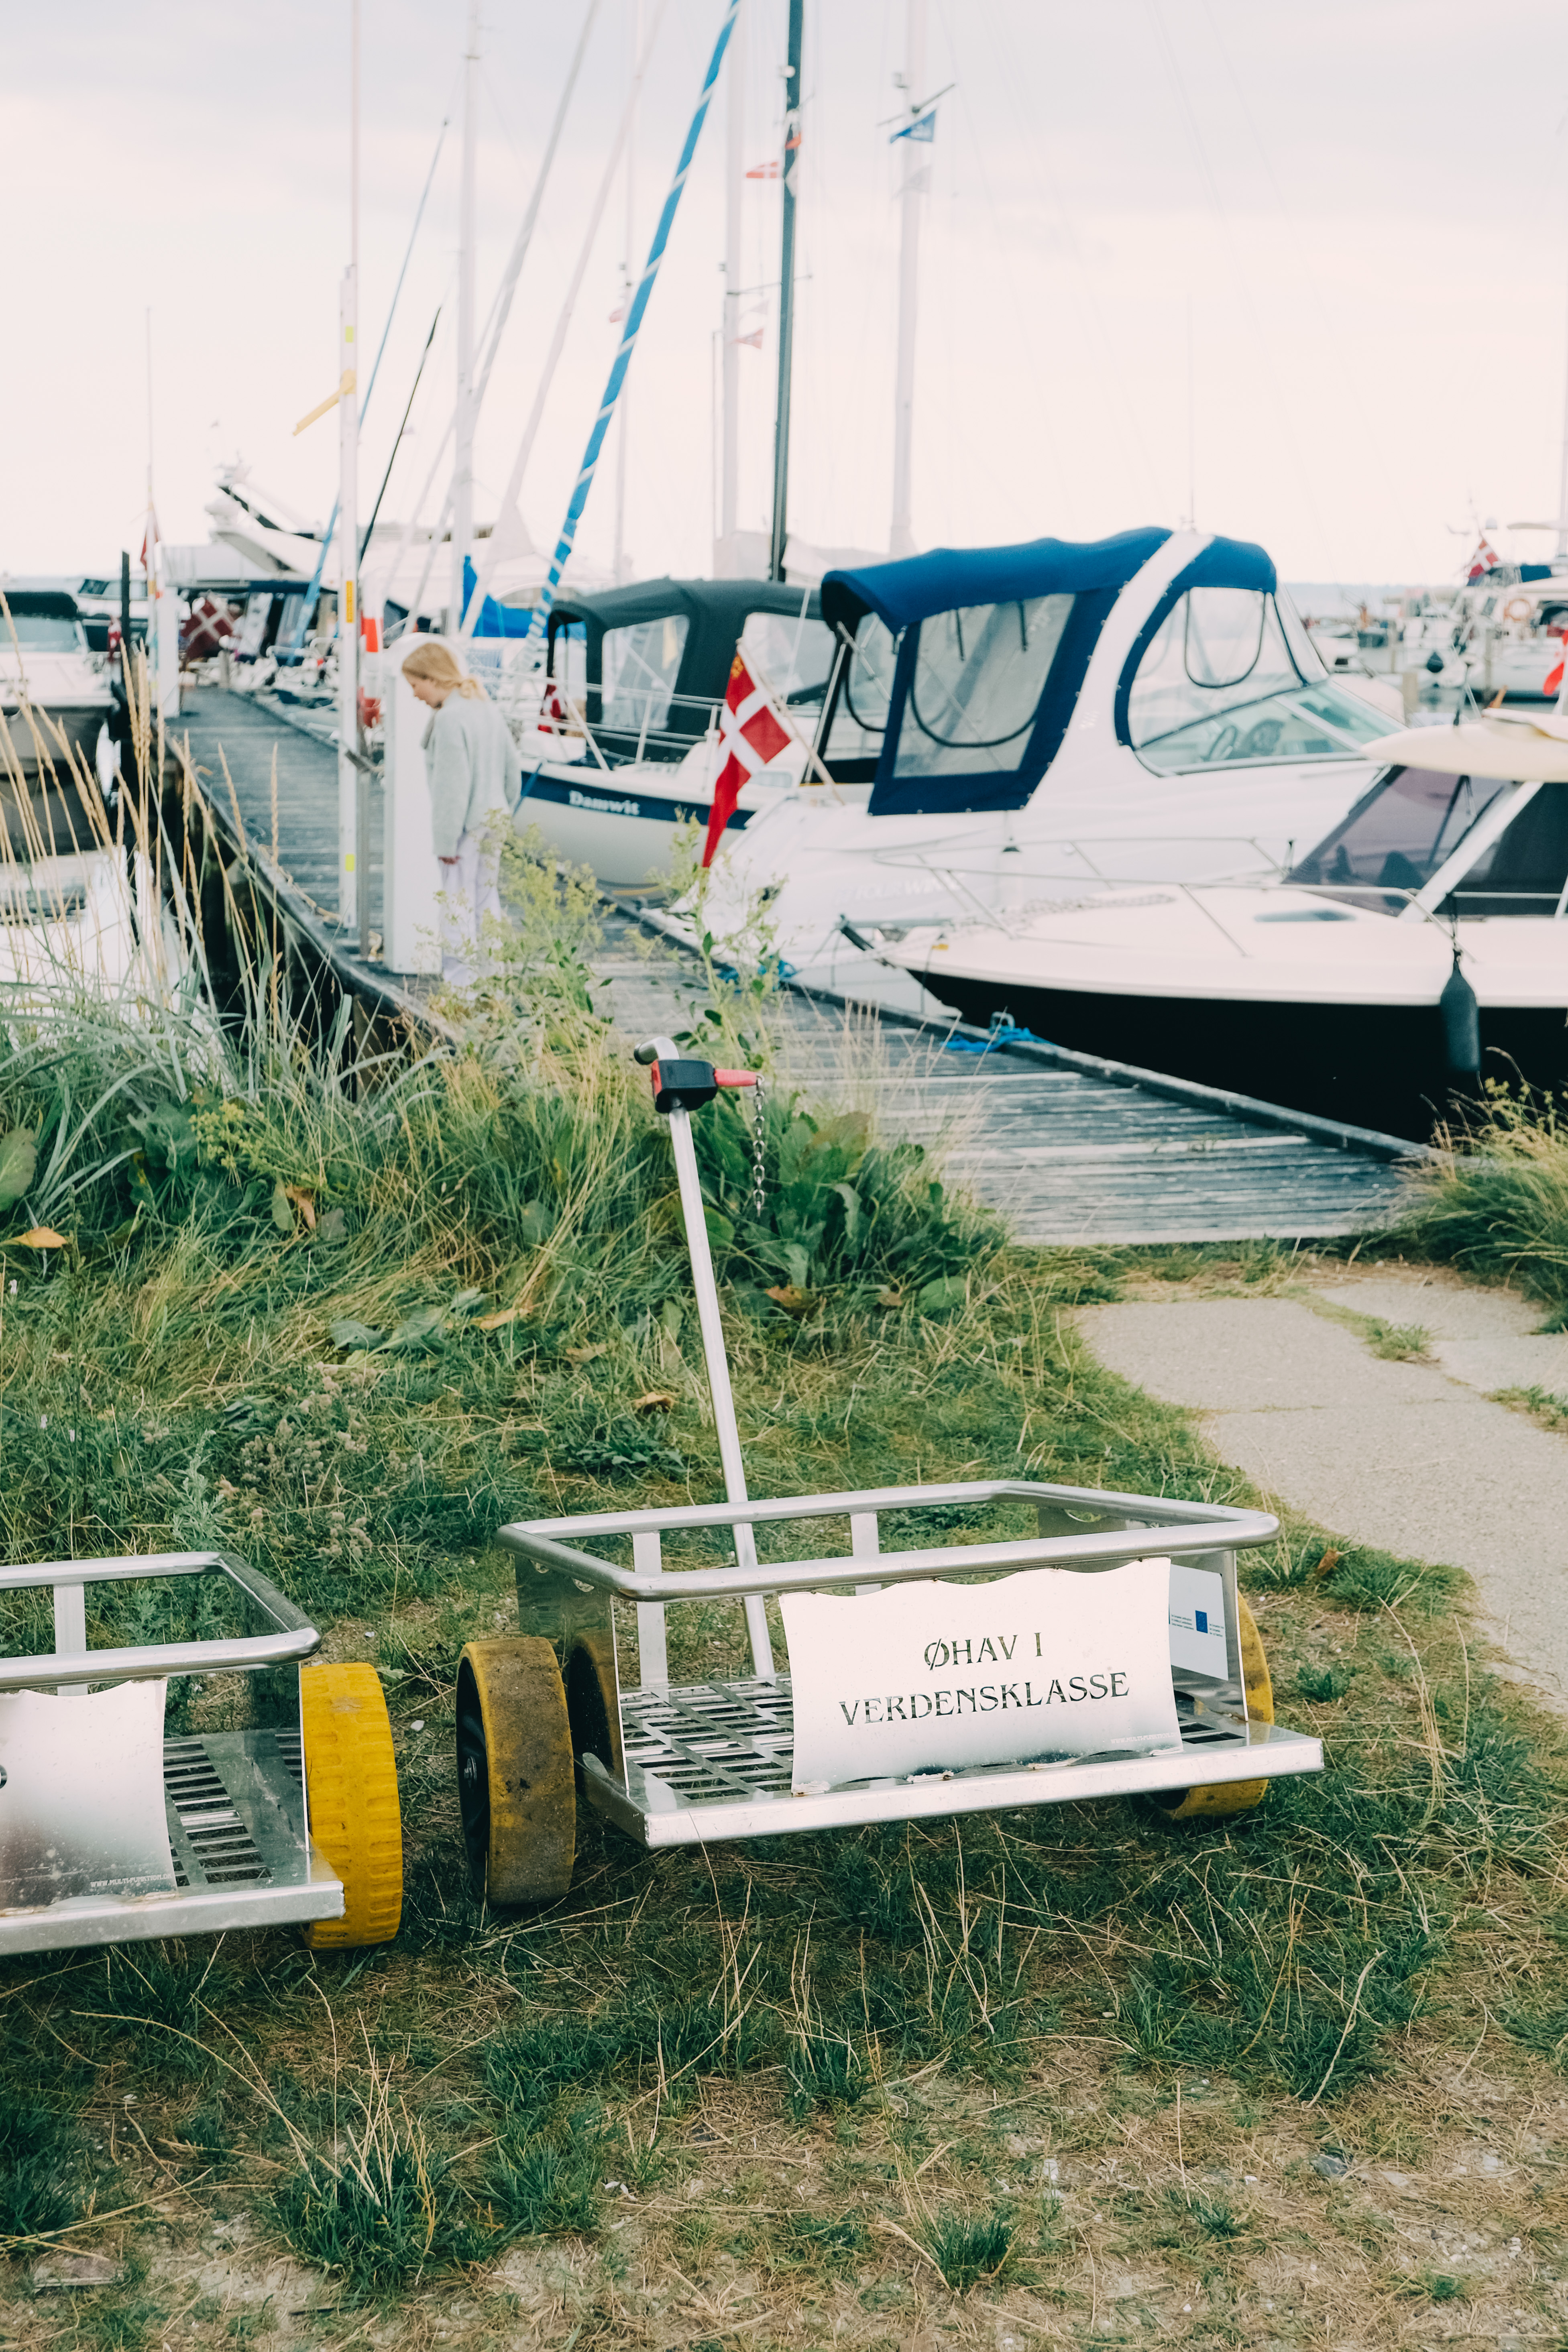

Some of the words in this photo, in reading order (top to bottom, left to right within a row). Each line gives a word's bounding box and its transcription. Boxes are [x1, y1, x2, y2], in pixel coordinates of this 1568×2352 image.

[924, 1635, 1018, 1671] ØHAV
[1034, 1632, 1043, 1657] I
[839, 1672, 1130, 1725] VERDENSKLASSE
